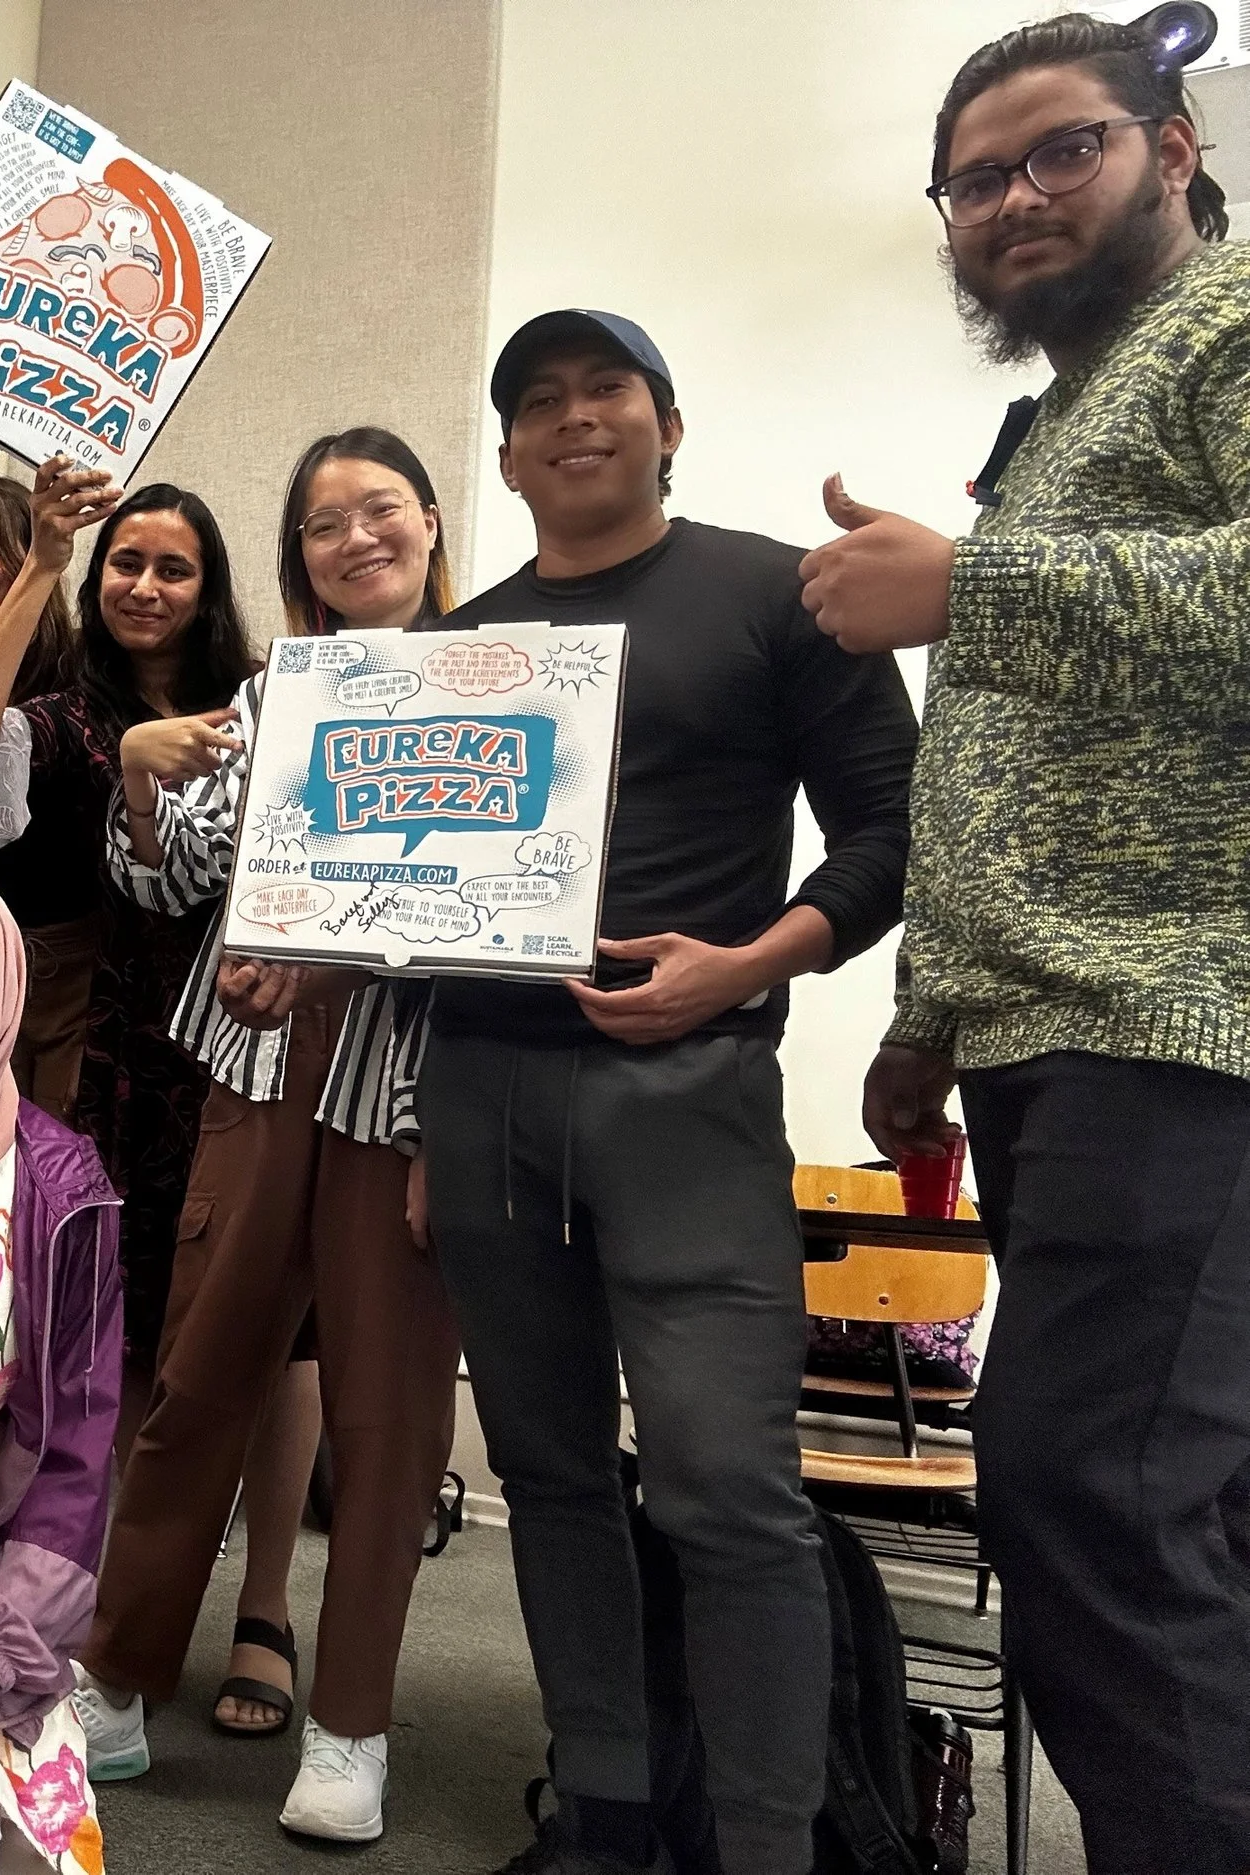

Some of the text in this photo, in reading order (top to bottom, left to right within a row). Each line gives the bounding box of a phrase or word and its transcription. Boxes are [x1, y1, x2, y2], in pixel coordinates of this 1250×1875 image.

[184, 212, 196, 227] DAY
[192, 228, 207, 250] YOUR
[194, 203, 212, 224] LIVE
[205, 224, 222, 247] WITH
[218, 219, 237, 237] BE
[552, 659, 591, 672] BE HELPFUL
[266, 811, 303, 826] LIVE WITH
[270, 823, 306, 836] POSITIVITY
[554, 835, 573, 852] BE
[533, 850, 577, 870] BRAVE
[248, 859, 452, 883] ORDER at EUREKAPIZZA.COM
[466, 881, 549, 892] EXPECT ONLY THE BEST
[256, 888, 309, 904] MAKE EACH DAY
[465, 892, 552, 901] IN ALL YOUR ENCOUNTERS
[251, 900, 318, 918] YOUR MASTERPIECE
[399, 899, 469, 918] TRUE TO YOURSELF
[395, 912, 413, 922] YOUR
[416, 915, 435, 927] PEACE
[438, 918, 449, 928] OF
[451, 920, 470, 932] MIND
